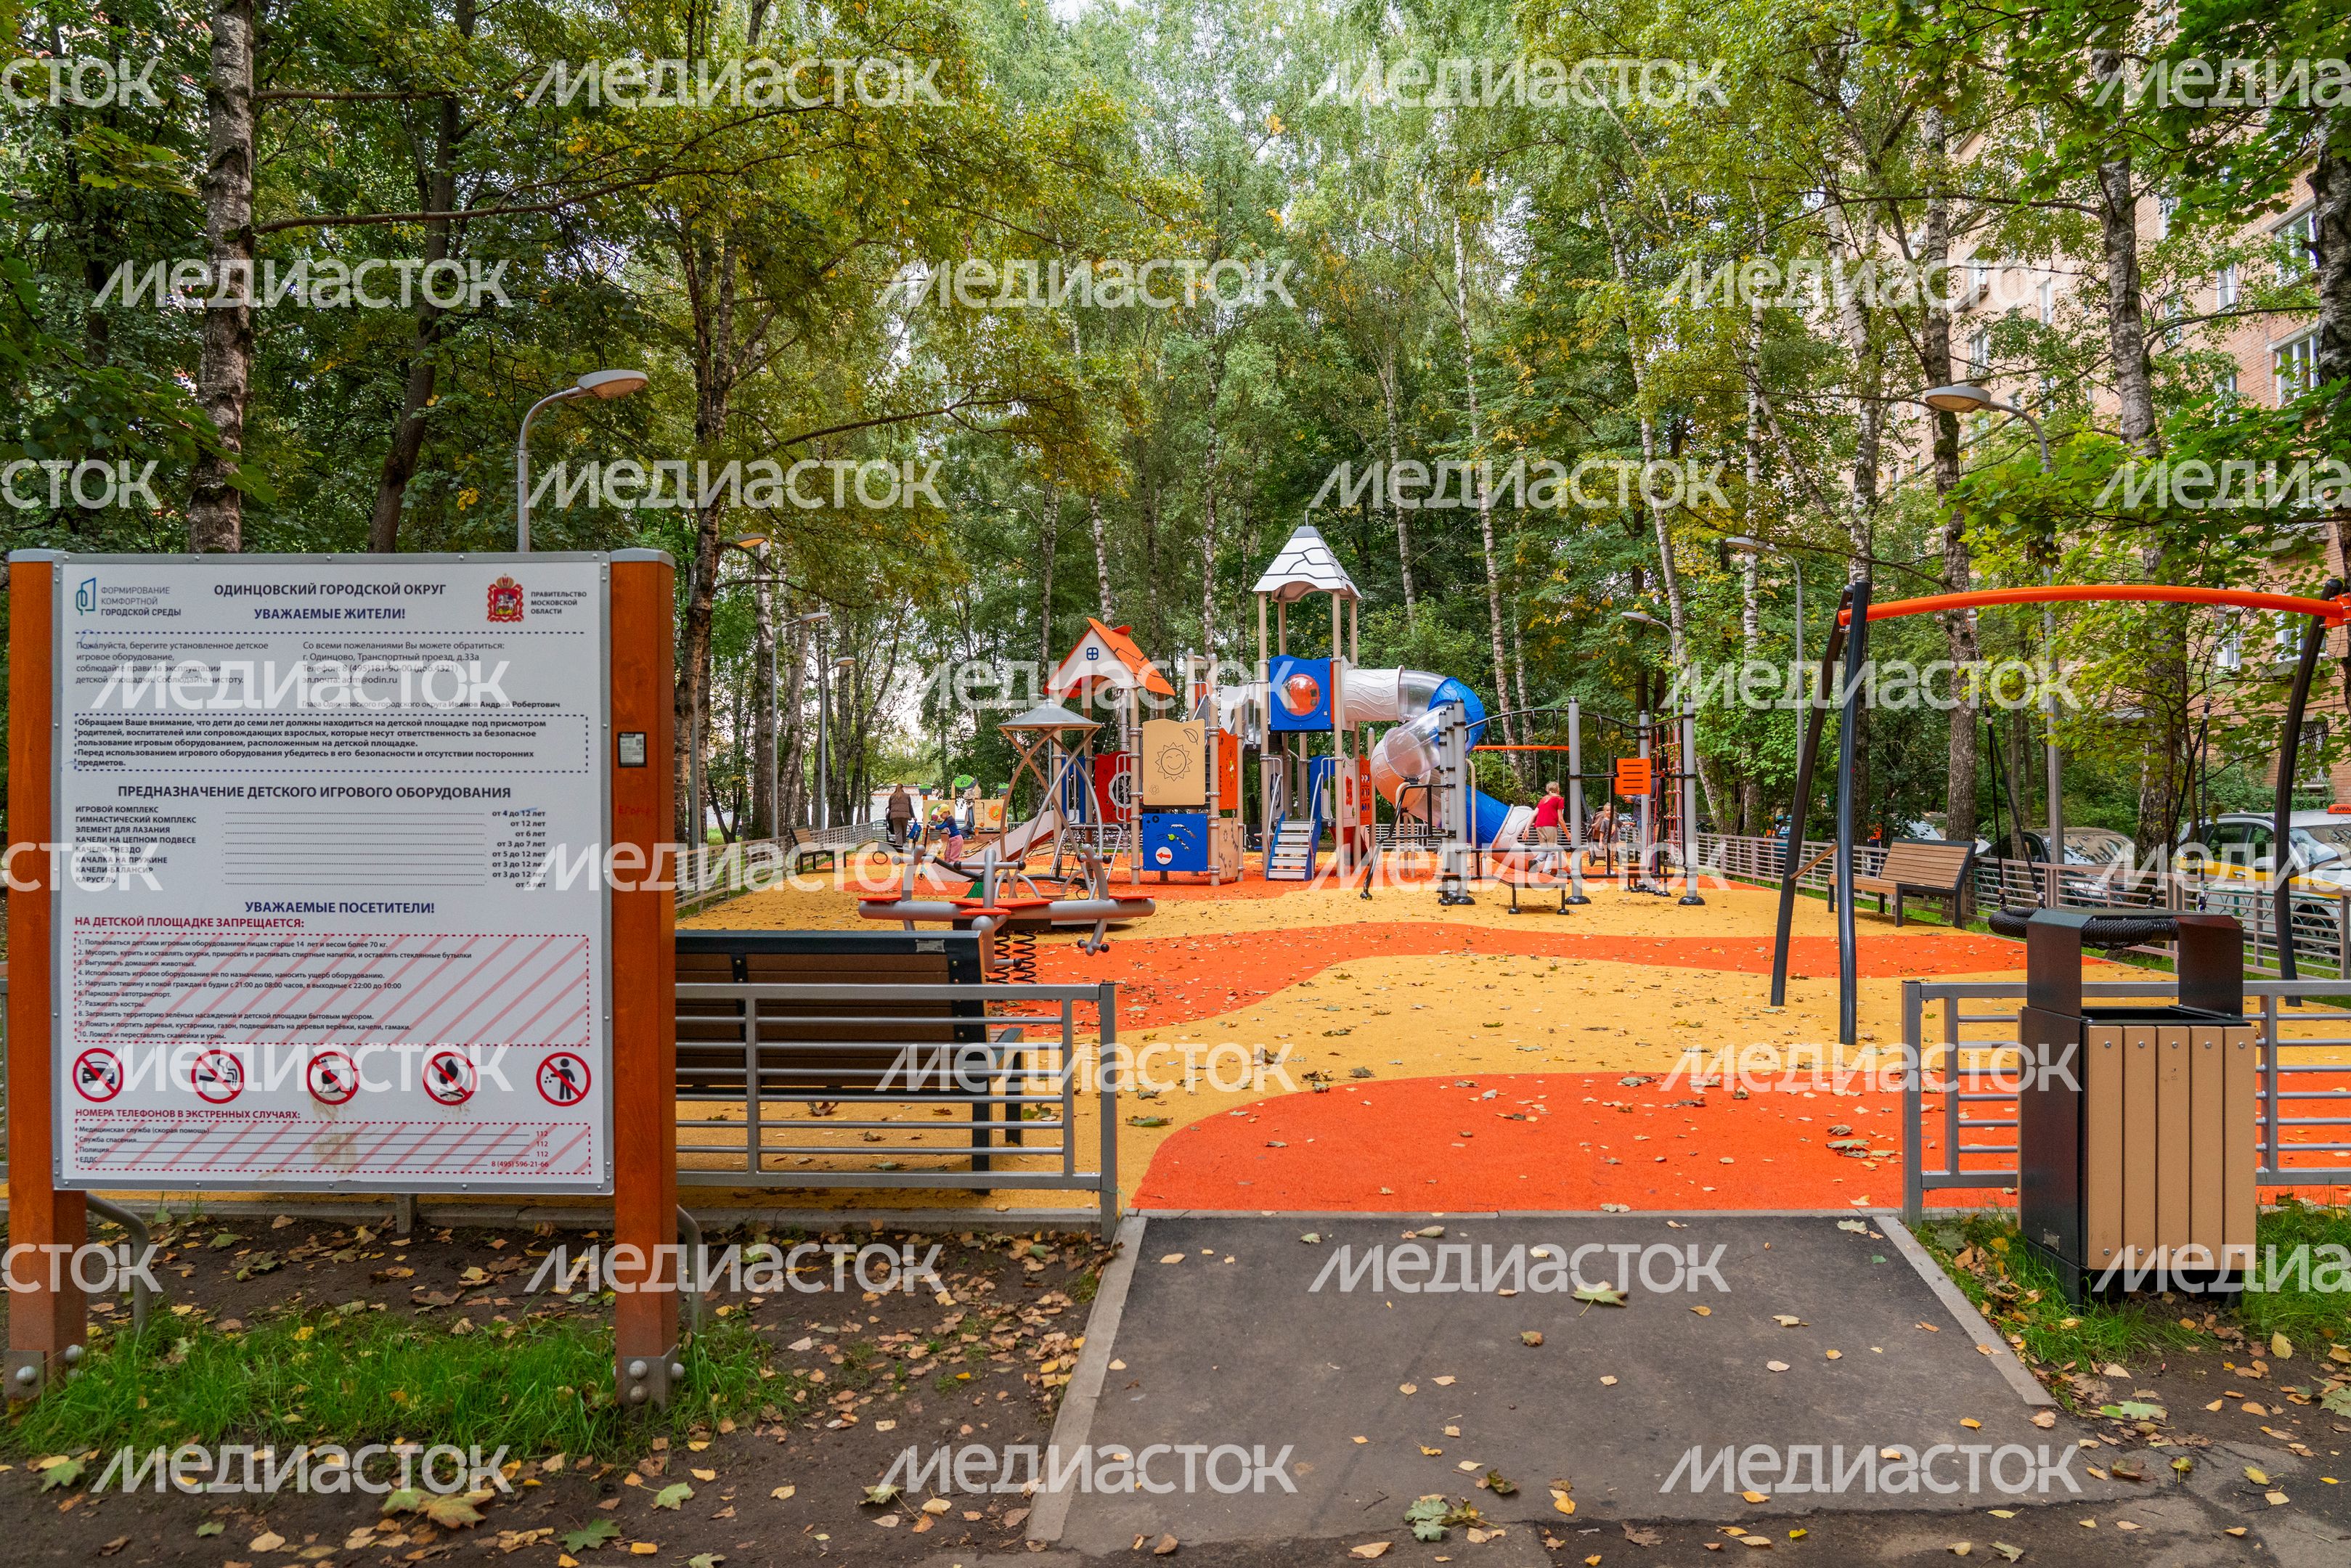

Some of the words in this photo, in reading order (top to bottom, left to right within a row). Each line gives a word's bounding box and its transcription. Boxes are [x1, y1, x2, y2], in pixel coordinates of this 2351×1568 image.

[214, 582, 317, 597] ОДИНЦОВСКИЙ
[319, 582, 401, 597] ГОРОДСКОЙ
[404, 584, 447, 595] ОКРУГ
[101, 597, 158, 605] КОМФОРТНОЙ
[101, 607, 150, 617] ГОРОДСКОЙ
[152, 608, 182, 617] СРЕДЫ
[254, 608, 341, 619] УВАЖАЕМЫЕ
[344, 608, 405, 619] ЖИТЕЛИ!
[76, 641, 128, 650] Пожалуйста,
[129, 641, 168, 651] берегите
[453, 642, 505, 650] обратиться:
[112, 653, 174, 662] оборудование,
[309, 653, 355, 661] Одинцово,
[358, 653, 420, 662] Транспортный
[456, 653, 479, 662] д.33а
[78, 718, 123, 727] Обращаем
[77, 728, 124, 738] родителей,
[174, 739, 245, 748] оборудованием,
[333, 739, 369, 748] детской
[77, 748, 105, 757] Перед
[219, 749, 282, 759] оборудования
[284, 749, 329, 759] убедитесь
[118, 786, 244, 799] ПРЕДНАЗНАЧЕНИЕ
[247, 786, 317, 800] ДЕТСКОГО
[320, 787, 393, 798] ИГРОВОГО
[396, 787, 511, 800] ОБОРУДОВАНИЯ
[245, 902, 335, 912] УВАЖАЕМЫЕ
[339, 902, 434, 913] ПОСЕТИТЕЛИ!
[75, 917, 90, 926] НА
[92, 915, 144, 928] ДЕТСКОЙ
[147, 918, 213, 928] ПЛОЩАДКЕ
[216, 918, 304, 930] ЗАПРЕЩАЕТСЯ:
